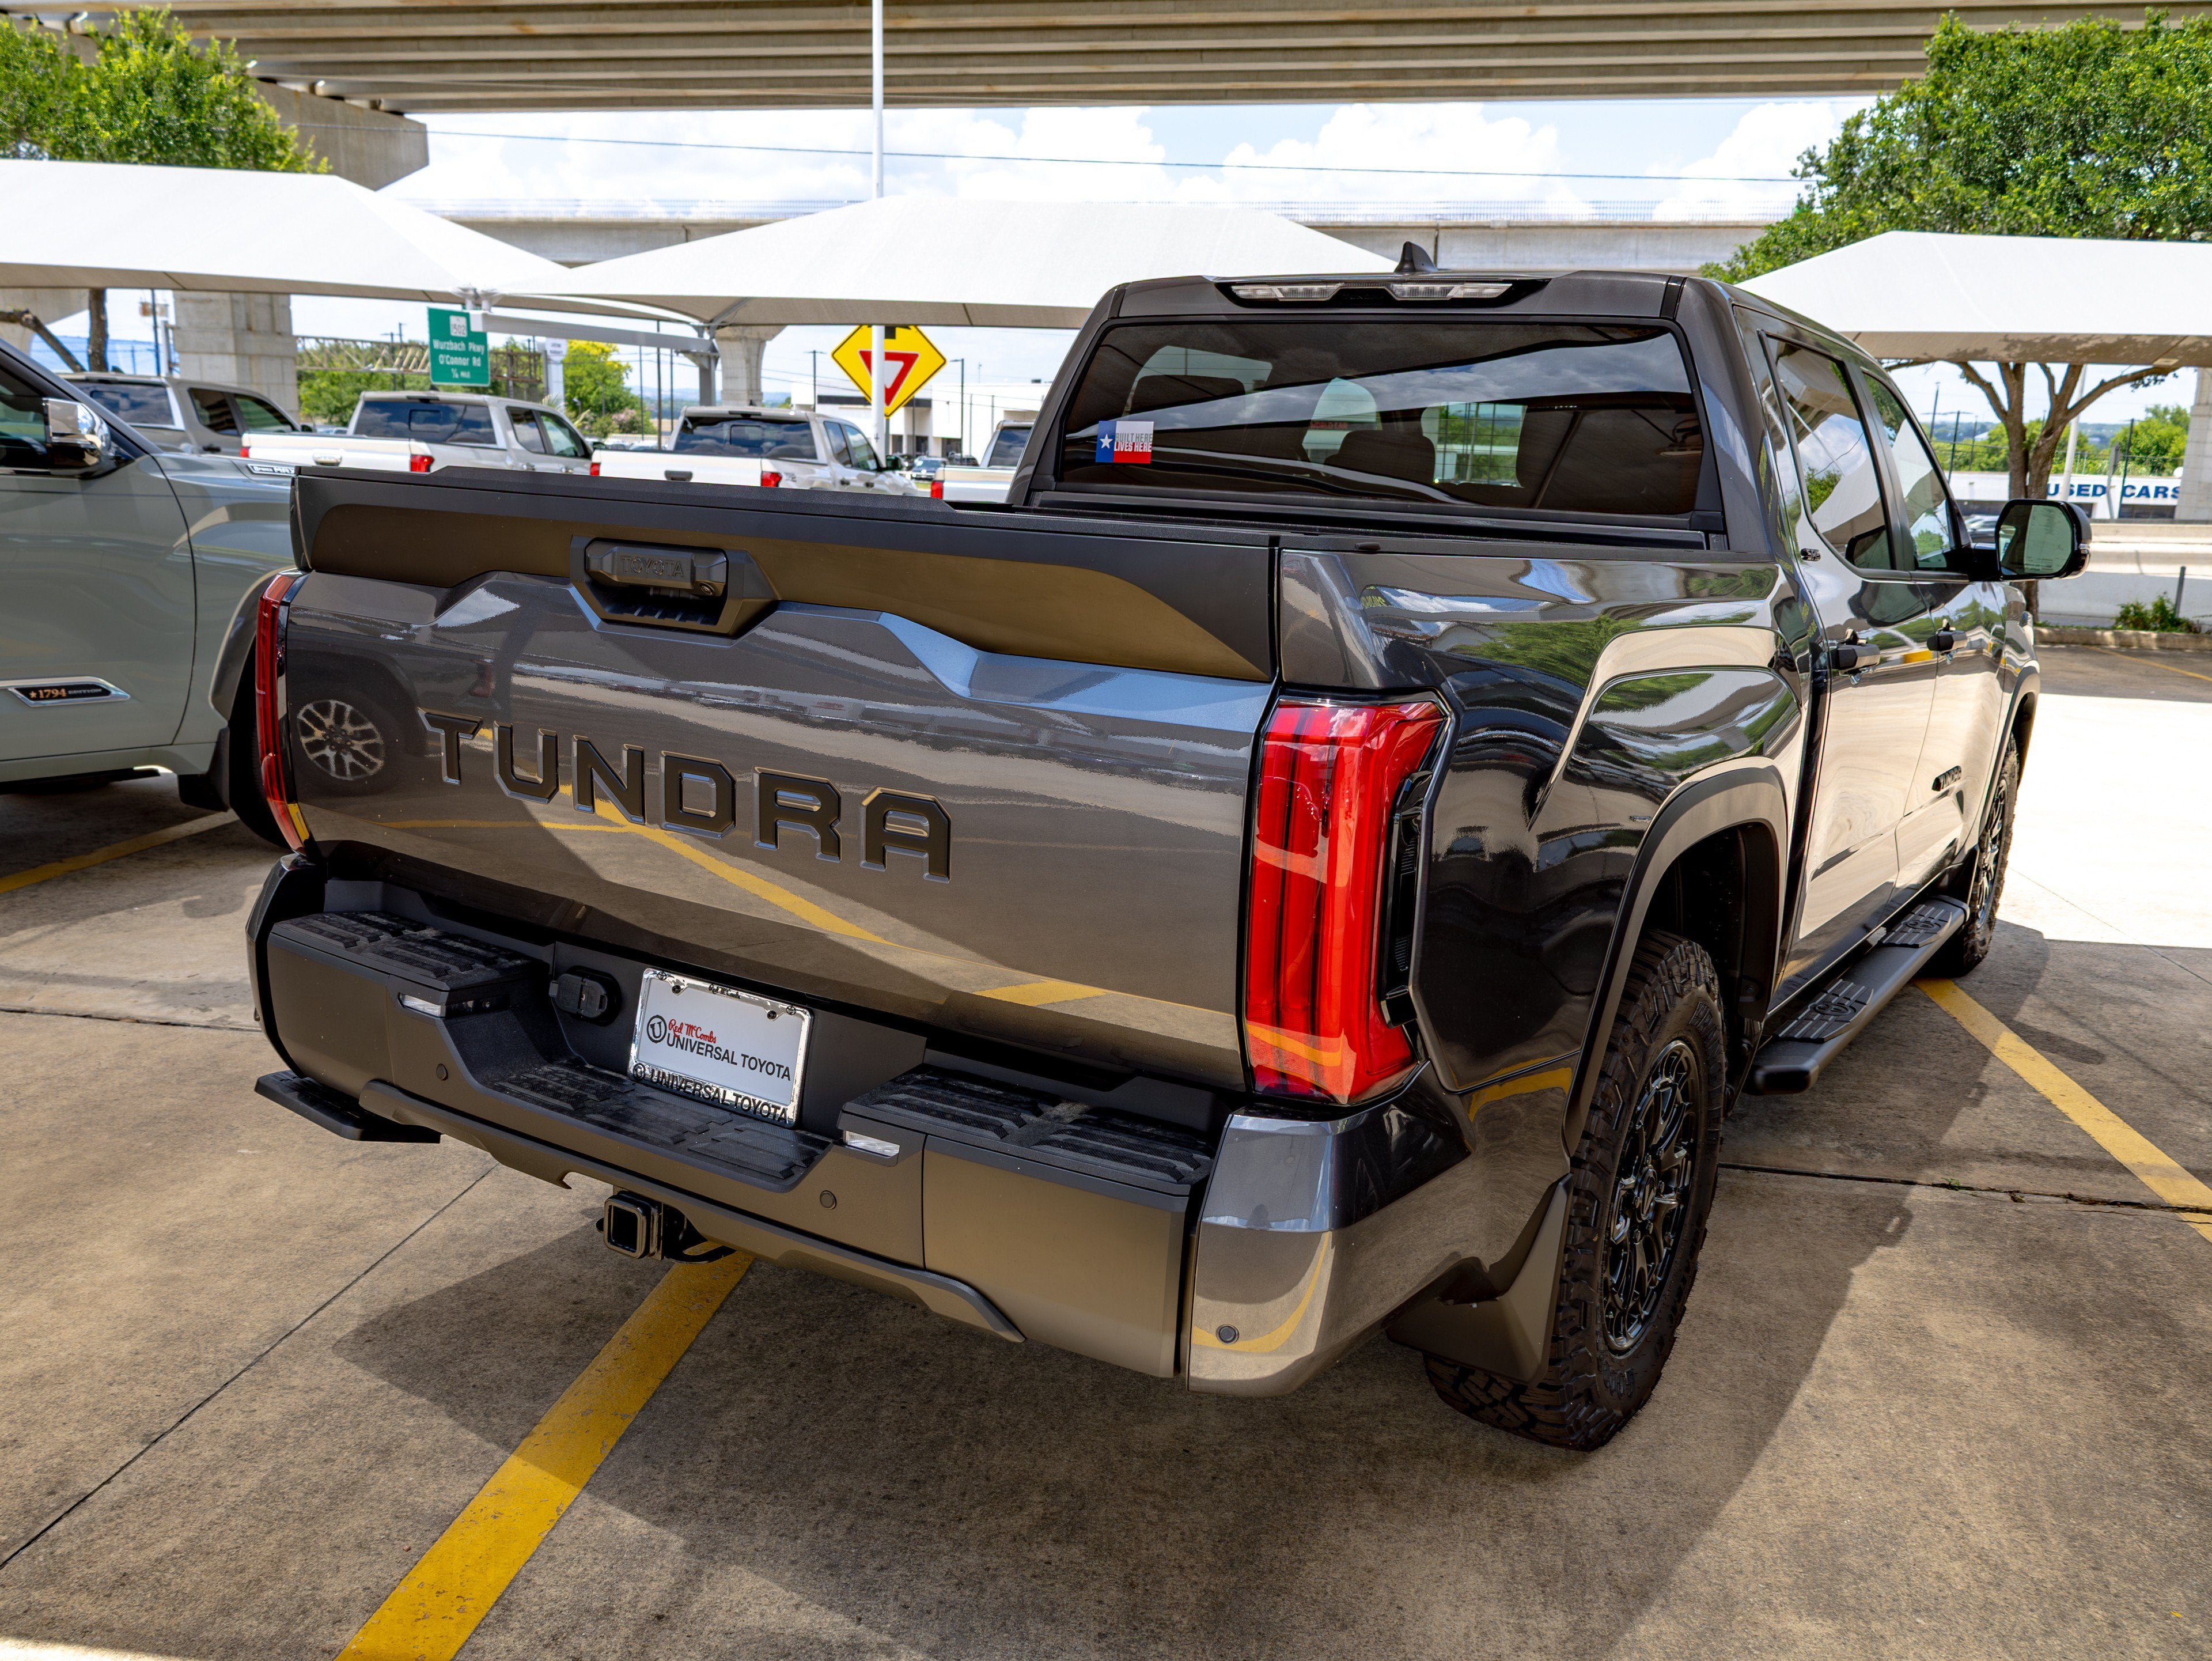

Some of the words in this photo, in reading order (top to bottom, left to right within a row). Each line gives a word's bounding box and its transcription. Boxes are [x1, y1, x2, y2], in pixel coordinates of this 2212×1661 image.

[433, 339, 465, 351] Wurzbach
[468, 342, 485, 355] Pkwy
[438, 354, 469, 366] O'Connor
[472, 355, 481, 367] Rd
[1113, 442, 1133, 452] LIVES
[1134, 442, 1152, 452] HERE
[1115, 433, 1135, 442] BUILT
[1135, 434, 1152, 442] HERE
[620, 555, 684, 577] TOYOTA
[38, 688, 67, 698] 1794
[417, 707, 952, 884] TUNDRA
[668, 1019, 684, 1038] Red
[685, 1023, 717, 1044] McCombs
[666, 1032, 738, 1066] UNIVERSAL
[740, 1053, 791, 1081] TOYOTA
[650, 1068, 730, 1106] UNIVERSAL
[732, 1093, 790, 1124] TOYOTA
